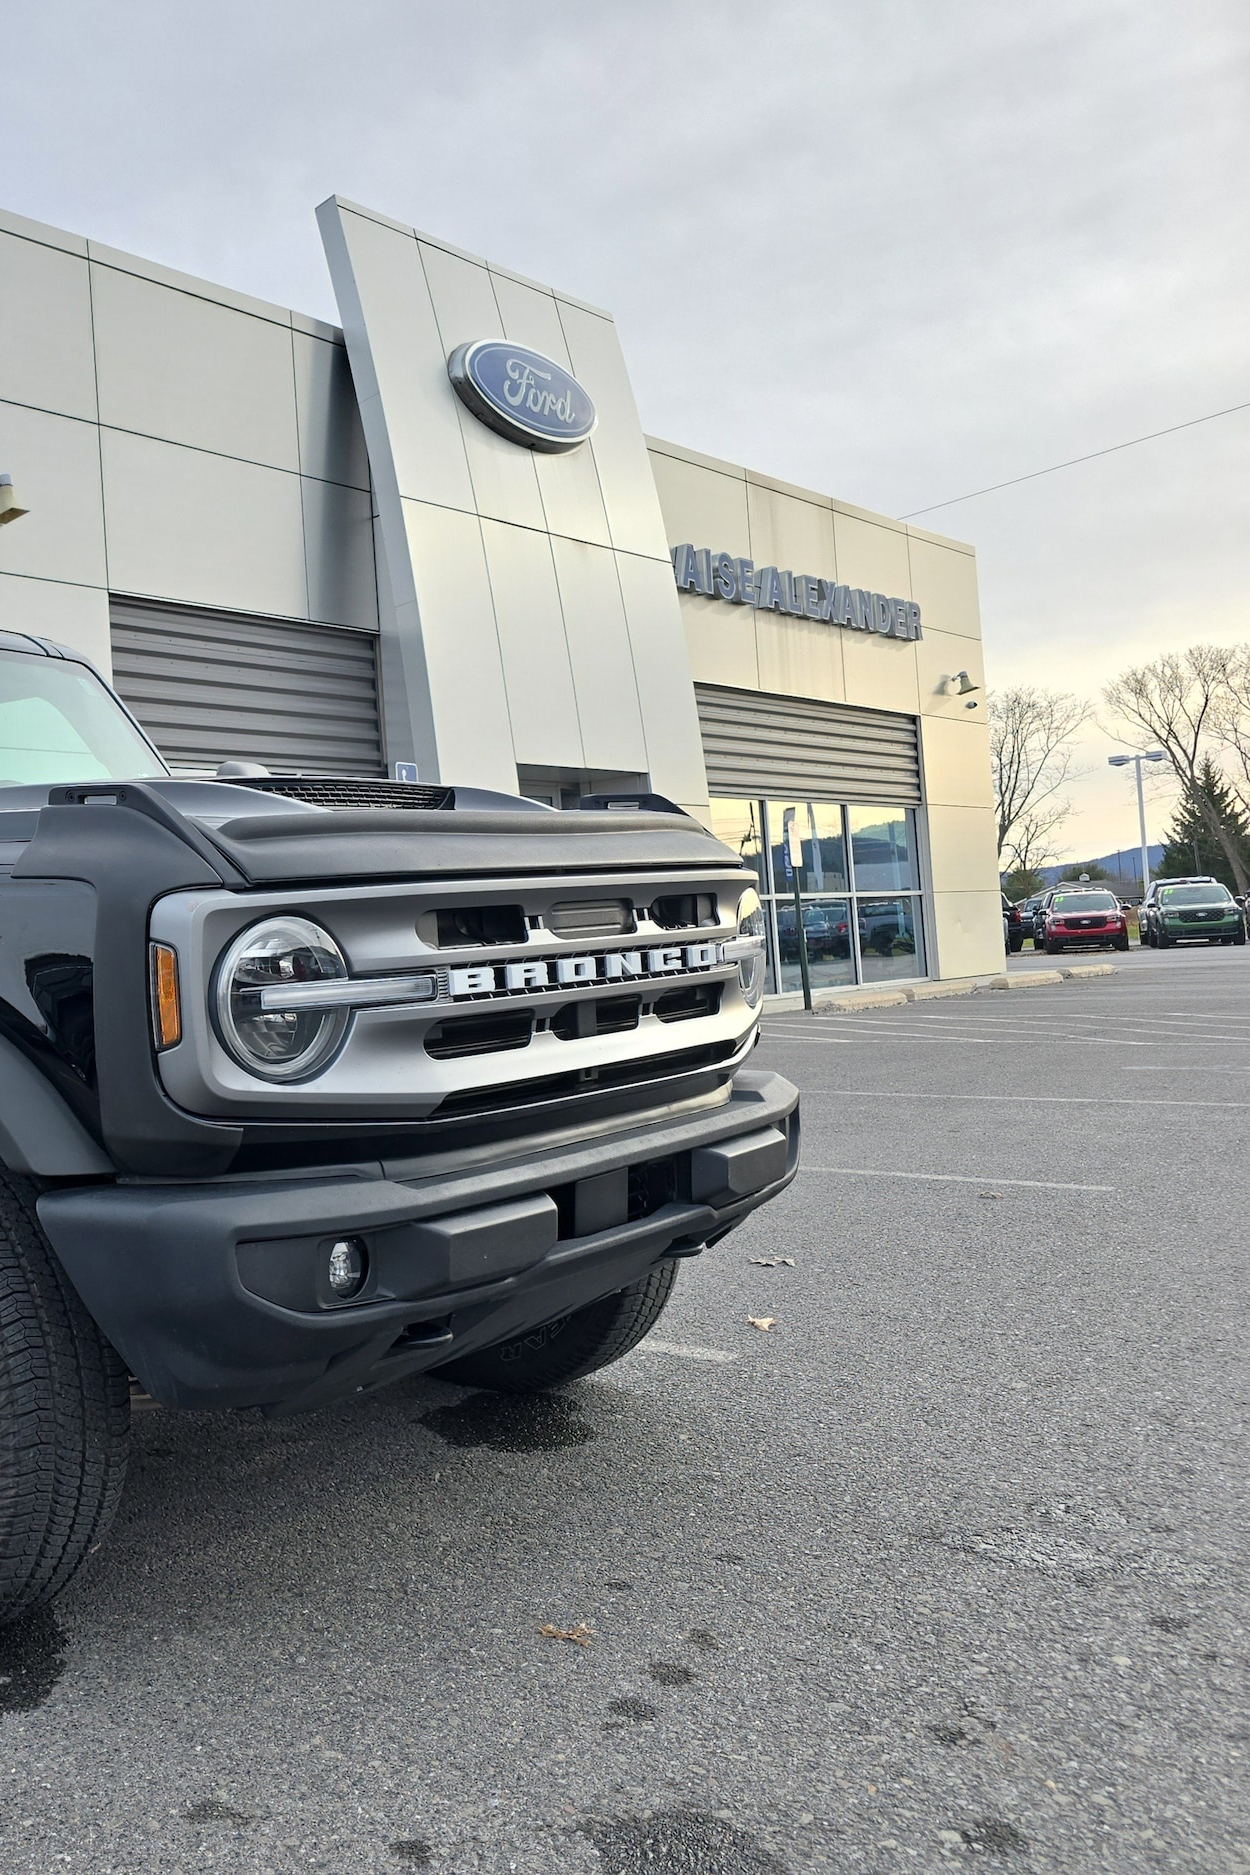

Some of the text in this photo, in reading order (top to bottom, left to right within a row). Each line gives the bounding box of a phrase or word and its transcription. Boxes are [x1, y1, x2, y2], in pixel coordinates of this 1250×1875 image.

[503, 358, 576, 425] Ford
[670, 543, 923, 641] AISE ALEXANDER
[449, 944, 718, 997] BRONCO
